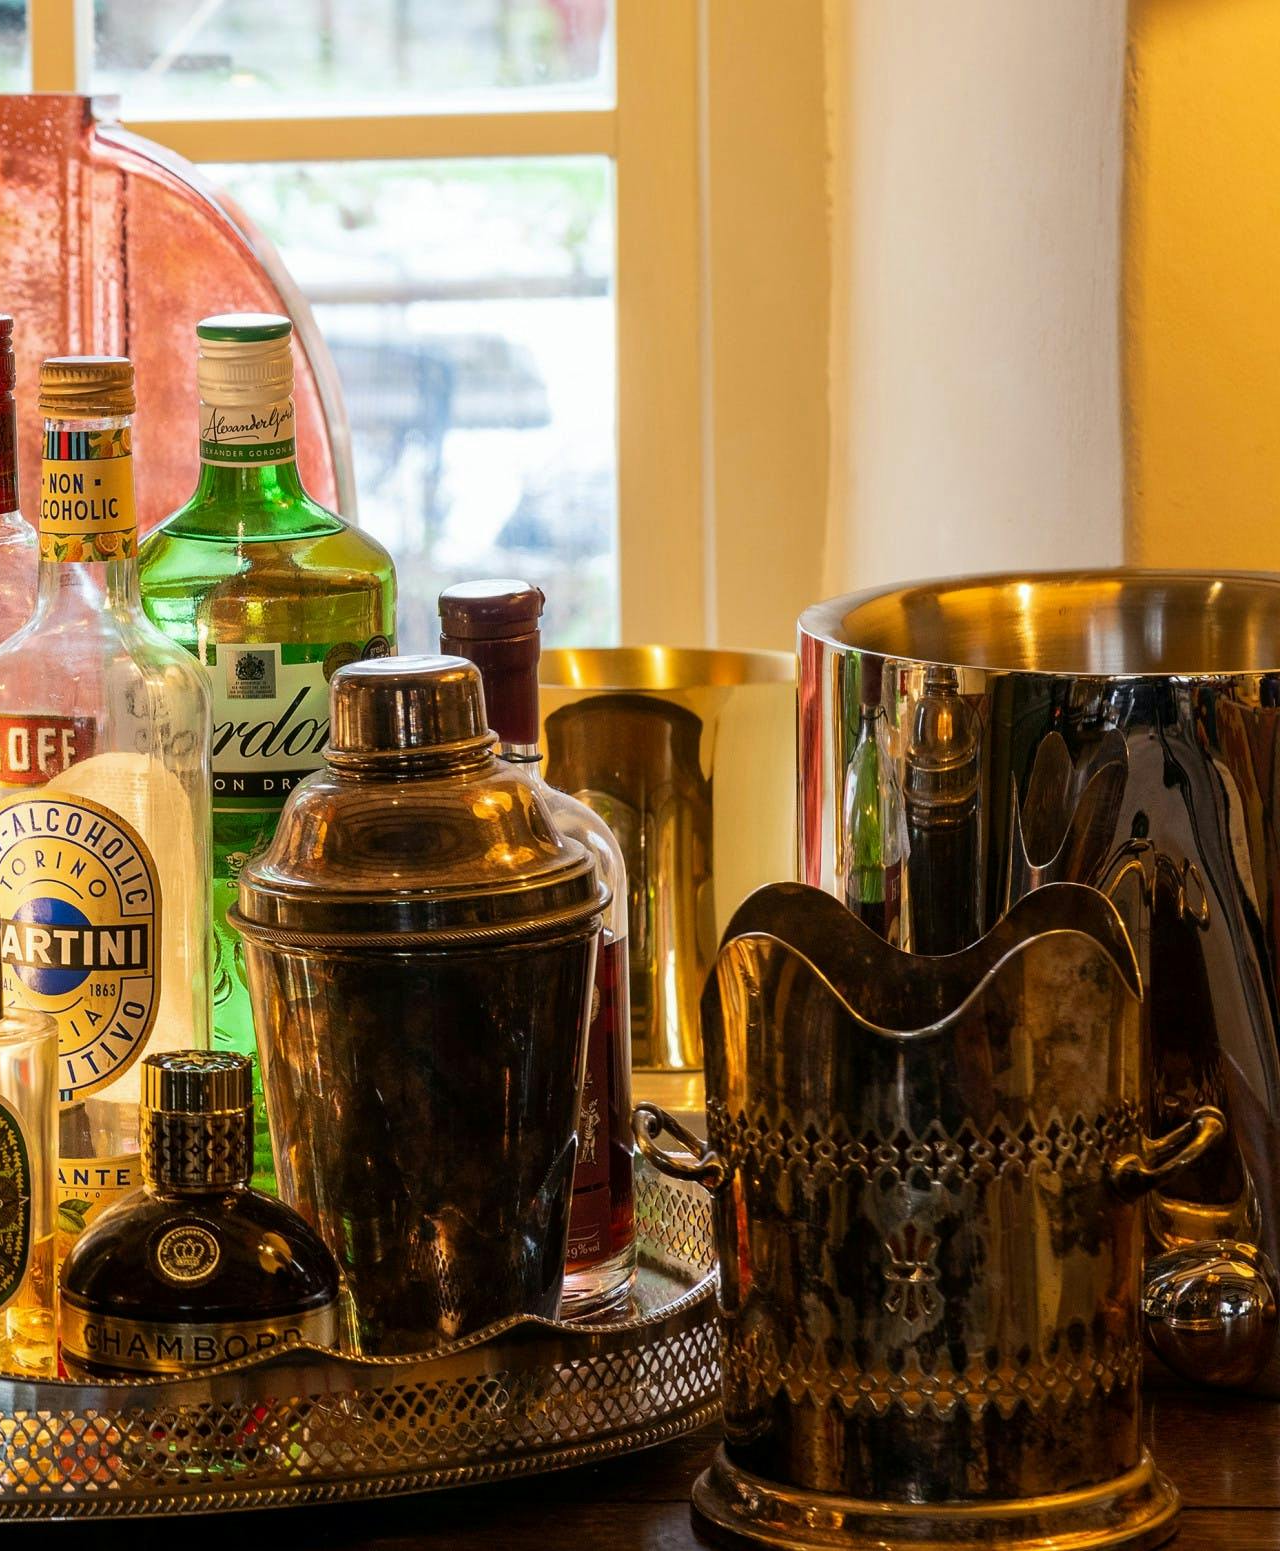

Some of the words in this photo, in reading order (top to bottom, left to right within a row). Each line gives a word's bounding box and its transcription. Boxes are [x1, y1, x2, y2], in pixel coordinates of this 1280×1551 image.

[249, 446, 288, 457] GORDON
[49, 473, 83, 494] NON
[40, 498, 118, 520] COHOLIC
[264, 779, 300, 791] DR
[0, 850, 107, 898] TORINO
[1, 924, 141, 966] ARTINI
[89, 983, 116, 998] 1863
[59, 1167, 130, 1186] ANTE
